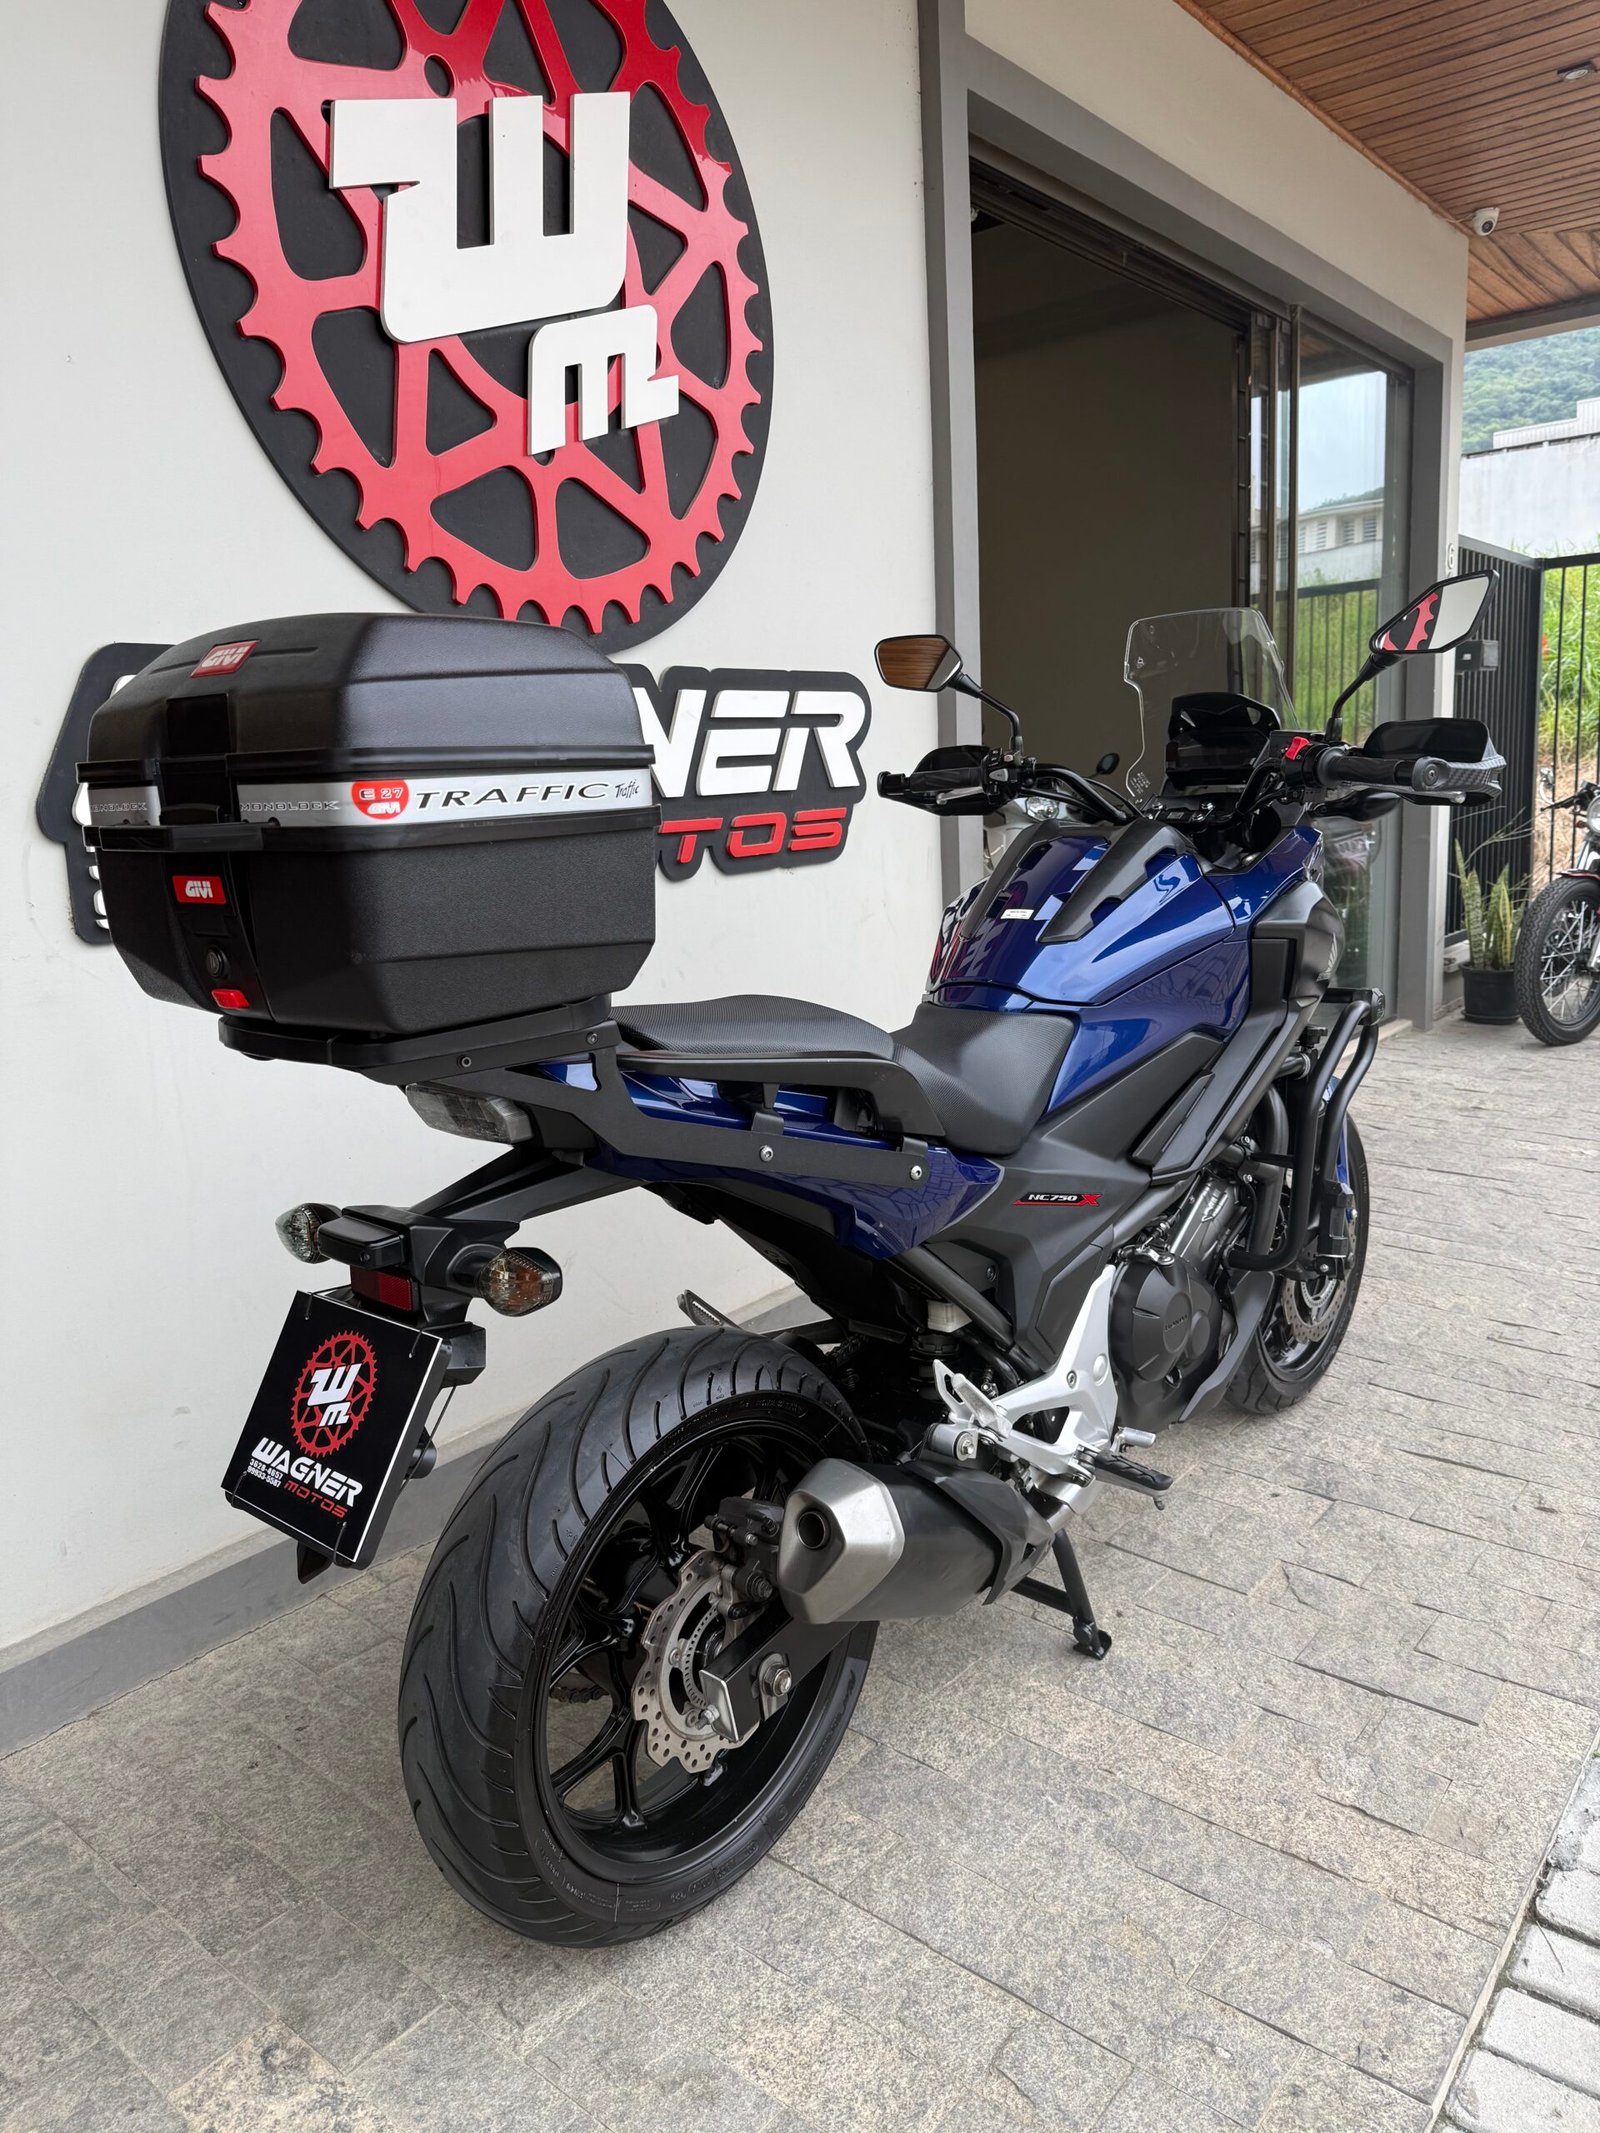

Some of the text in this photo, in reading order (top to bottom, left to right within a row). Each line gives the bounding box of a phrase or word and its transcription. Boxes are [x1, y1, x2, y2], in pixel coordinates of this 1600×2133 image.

[201, 645, 251, 668] GIVI
[239, 799, 340, 812] MONOLOCK
[358, 787, 402, 800] E 27
[415, 778, 640, 810] TRAFFIC Traffic
[658, 807, 848, 864] TOS
[184, 879, 214, 899] GIVI
[251, 1436, 363, 1508] WAGNER
[283, 1480, 348, 1519] MOTOS
